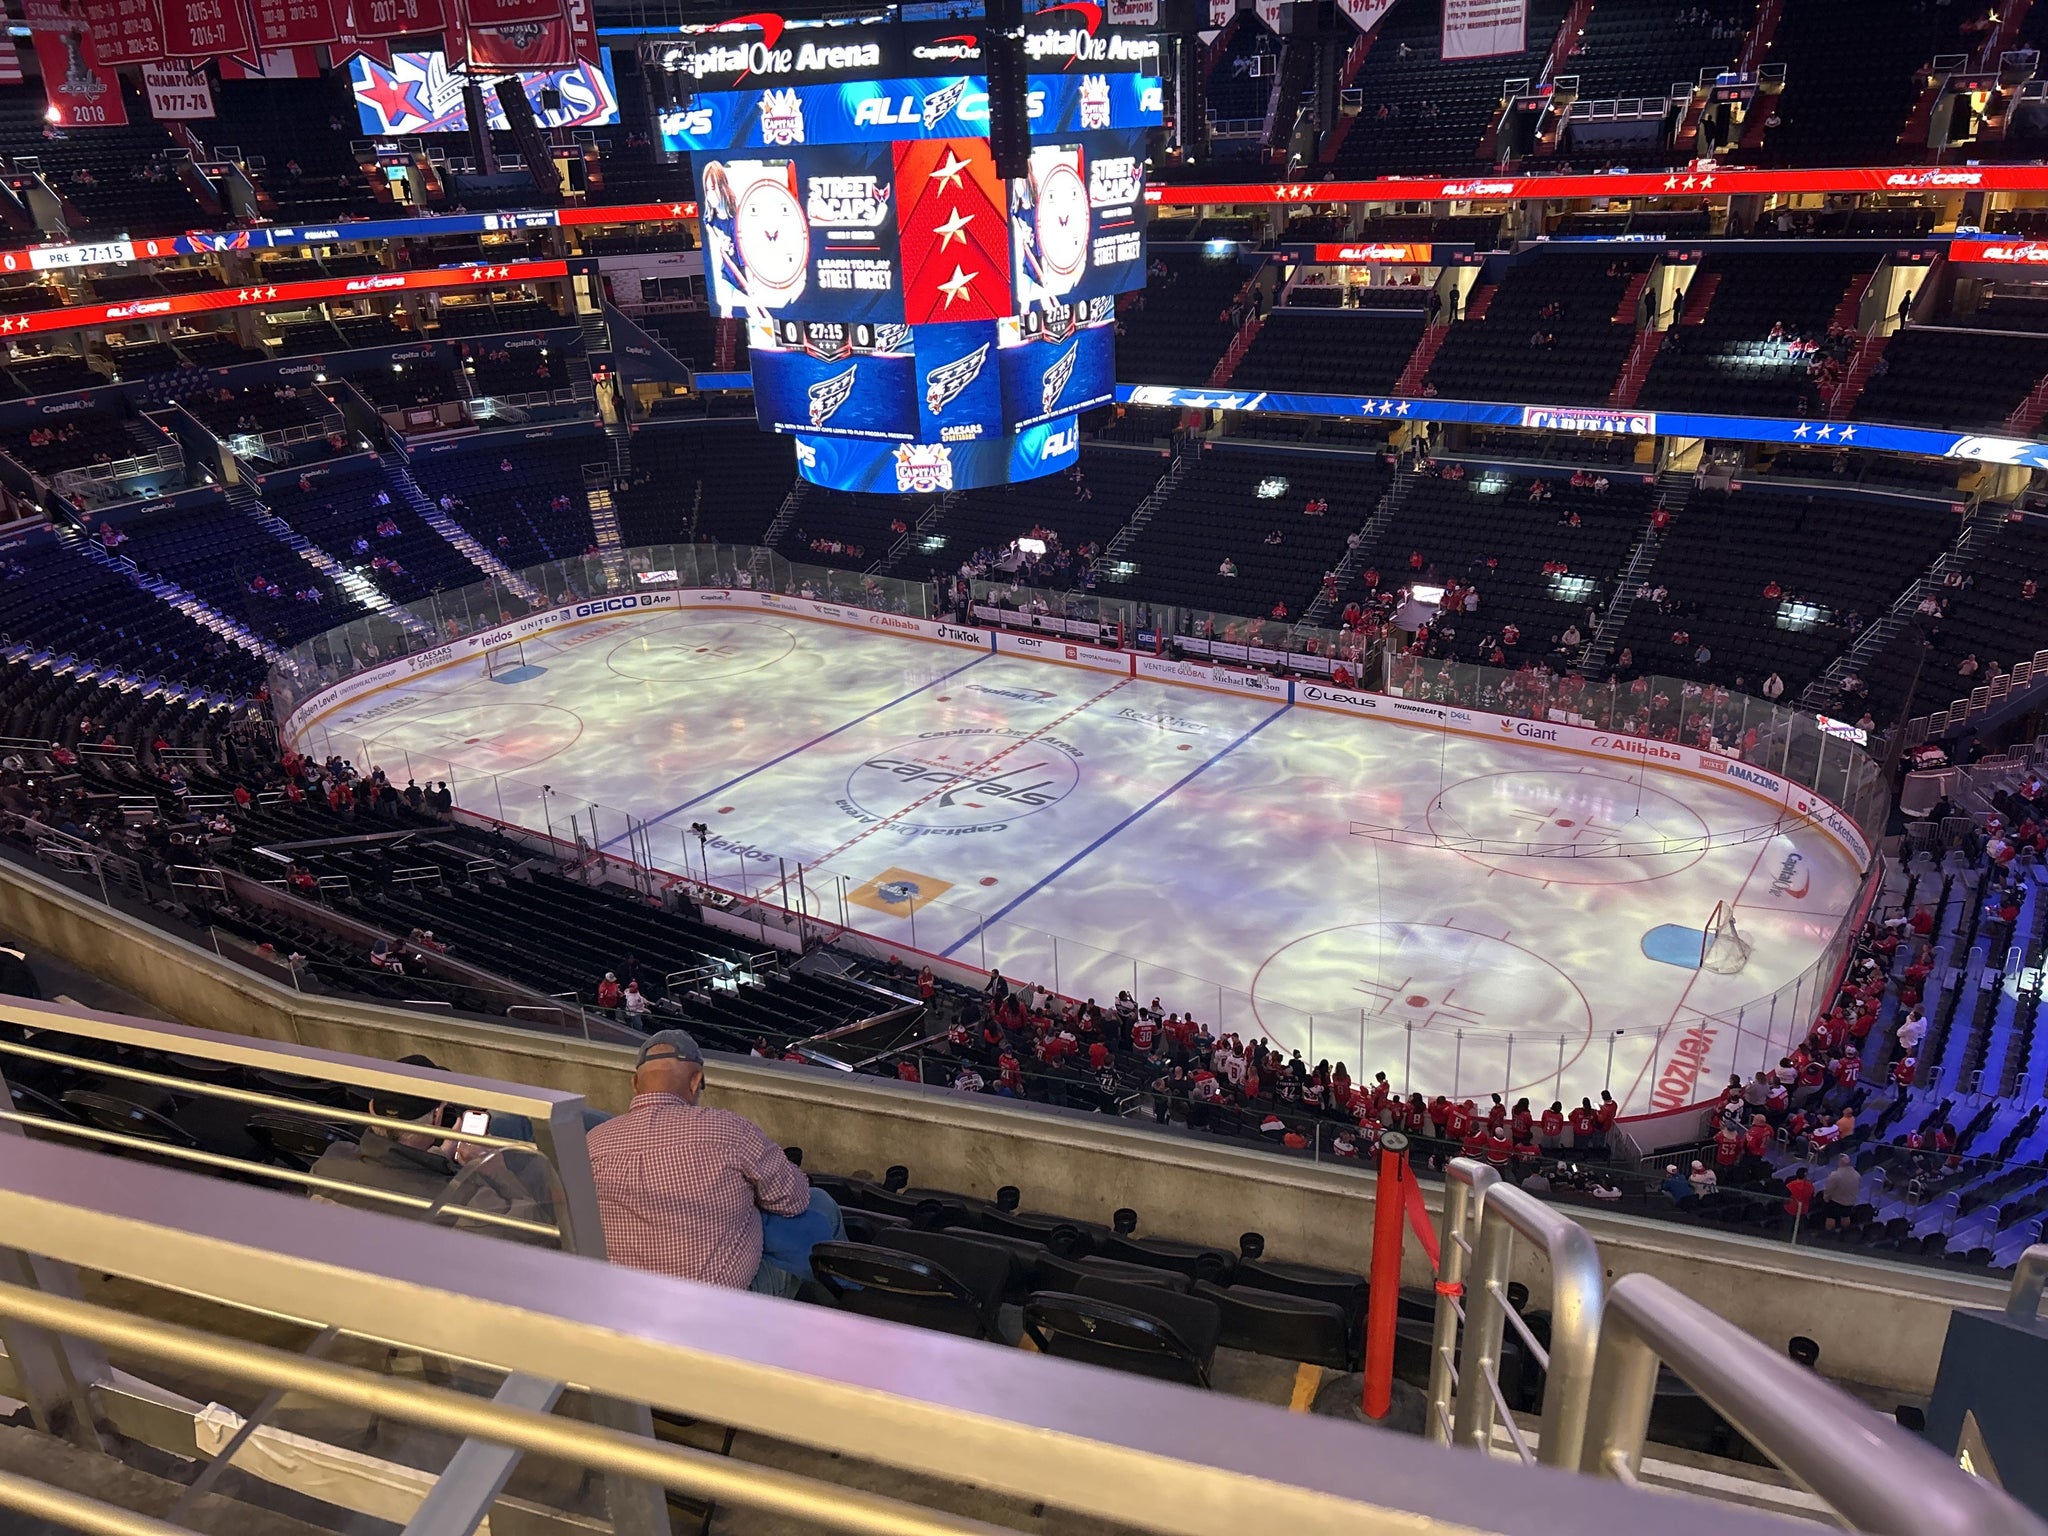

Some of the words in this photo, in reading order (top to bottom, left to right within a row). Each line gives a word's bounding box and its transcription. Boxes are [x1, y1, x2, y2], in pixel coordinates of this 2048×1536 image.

[186, 1, 222, 23] 2015-16
[290, 5, 318, 20] 2012-13
[371, 0, 419, 23] 2017-18
[1112, 2, 1153, 16] CHAMPIONS
[190, 24, 227, 47] 2016-17
[1108, 34, 1160, 60] Arena
[795, 42, 880, 71] Arena
[147, 73, 206, 87] CHAMPIONS
[154, 93, 208, 111] 1977-78
[854, 95, 921, 126] ALL
[73, 105, 105, 122] 2018
[808, 175, 877, 199] STREET
[1887, 173, 1919, 185] ALL
[1932, 172, 1982, 186] CAPS
[1442, 184, 1466, 195] ALL
[1475, 183, 1514, 194] CAPS
[828, 198, 876, 220] CAPS
[50, 253, 70, 264] PRE
[80, 244, 123, 262] 27:15
[147, 241, 156, 255] 0
[1339, 248, 1362, 259] ALL
[1370, 248, 1406, 259] CAPS
[1983, 247, 2014, 260] ALL
[2027, 248, 2048, 261] CA
[5, 254, 16, 270] 0
[347, 280, 369, 291] ALL
[374, 277, 405, 288] CAPS
[818, 269, 852, 288] STREET
[106, 305, 128, 318] ALL
[137, 301, 170, 313] CAPS
[1047, 304, 1071, 323] 27:15
[1079, 300, 1087, 320] 0
[1029, 311, 1038, 332] 0
[786, 322, 798, 342] 0
[809, 323, 844, 340] 27:15
[857, 324, 869, 346] 0
[940, 424, 983, 436] CAESARS
[1041, 434, 1075, 462] ALL
[576, 596, 638, 618] GEICO
[520, 615, 558, 631] UNITED
[881, 617, 920, 631] Alibaba
[481, 628, 513, 647] leidos
[948, 628, 980, 644] TikTok
[1017, 637, 1043, 648] GDIT
[417, 647, 452, 663] CAESARS
[1143, 661, 1177, 674] VENTURE
[1177, 668, 1207, 679] GLOBAL
[1212, 673, 1244, 686] Michael
[319, 690, 338, 708] Level
[1323, 691, 1377, 708] LEXUS
[1393, 703, 1437, 715] THUNDERCAT
[1450, 711, 1472, 721] DELL
[1517, 722, 1557, 741] Giant
[1039, 735, 1085, 758] Arena
[1611, 738, 1682, 762] Alibaba
[1727, 764, 1779, 793] AMAZING
[835, 799, 878, 825] Arena
[704, 835, 775, 863] leidos
[1651, 1028, 1718, 1110] verizon
[1353, 1104, 1367, 1118] 28
[1454, 1116, 1462, 1129] 8
